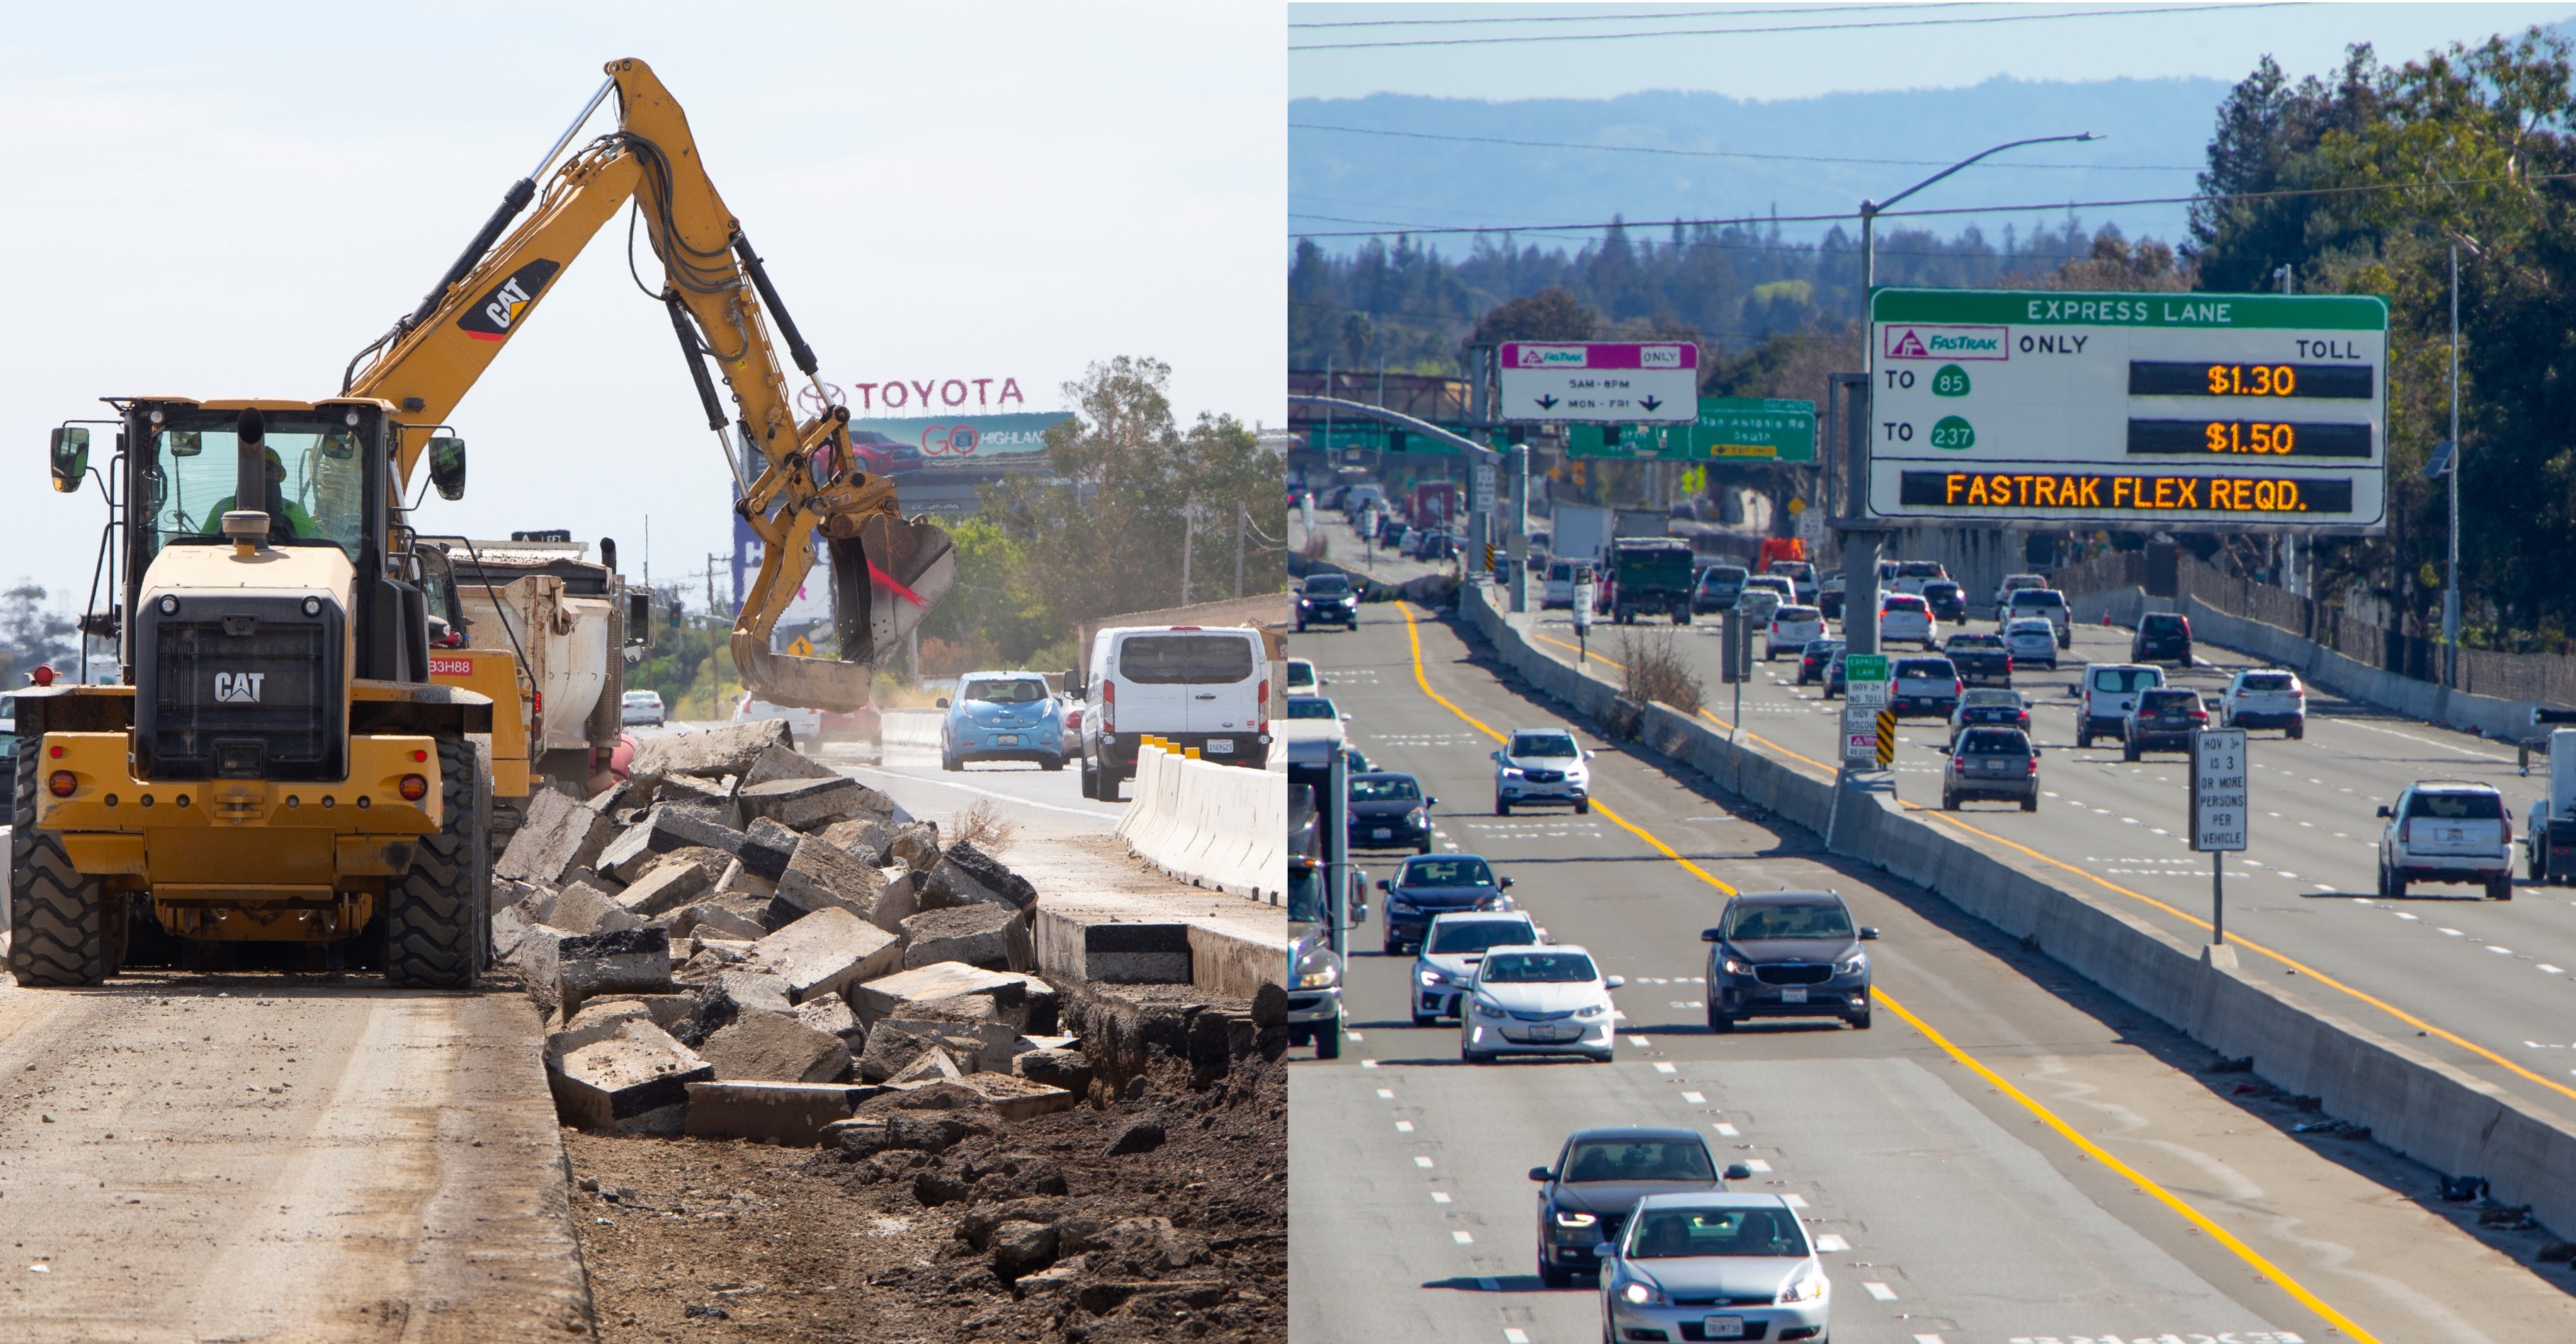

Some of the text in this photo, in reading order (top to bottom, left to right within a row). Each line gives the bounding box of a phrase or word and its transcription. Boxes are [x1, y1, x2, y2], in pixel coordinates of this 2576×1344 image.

[486, 277, 530, 328] CAT
[2028, 300, 2231, 322] EXPRESS LANE
[2020, 336, 2088, 354] ONLY
[2296, 340, 2361, 359] TOLL
[1644, 352, 1676, 362] ONLY
[1885, 370, 1963, 391] TO 85
[2208, 365, 2296, 396] $1.30
[856, 377, 1024, 409] TOYOTA
[922, 423, 979, 455] GO
[1883, 423, 1971, 445] TO 237
[2206, 422, 2295, 455] $1.50
[1947, 474, 2309, 511] FASTRAK FLEX REQD.
[215, 672, 264, 702] CAT
[1849, 694, 1860, 702] NO
[1847, 721, 1876, 729] DISCOU
[2203, 738, 2240, 750] HOV 3+
[2210, 756, 2234, 770] IS 3
[2201, 776, 2243, 789] OR MORE
[2200, 795, 2244, 807] PERSONS
[2213, 814, 2231, 826] PER
[2202, 831, 2242, 844] VEHICLE
